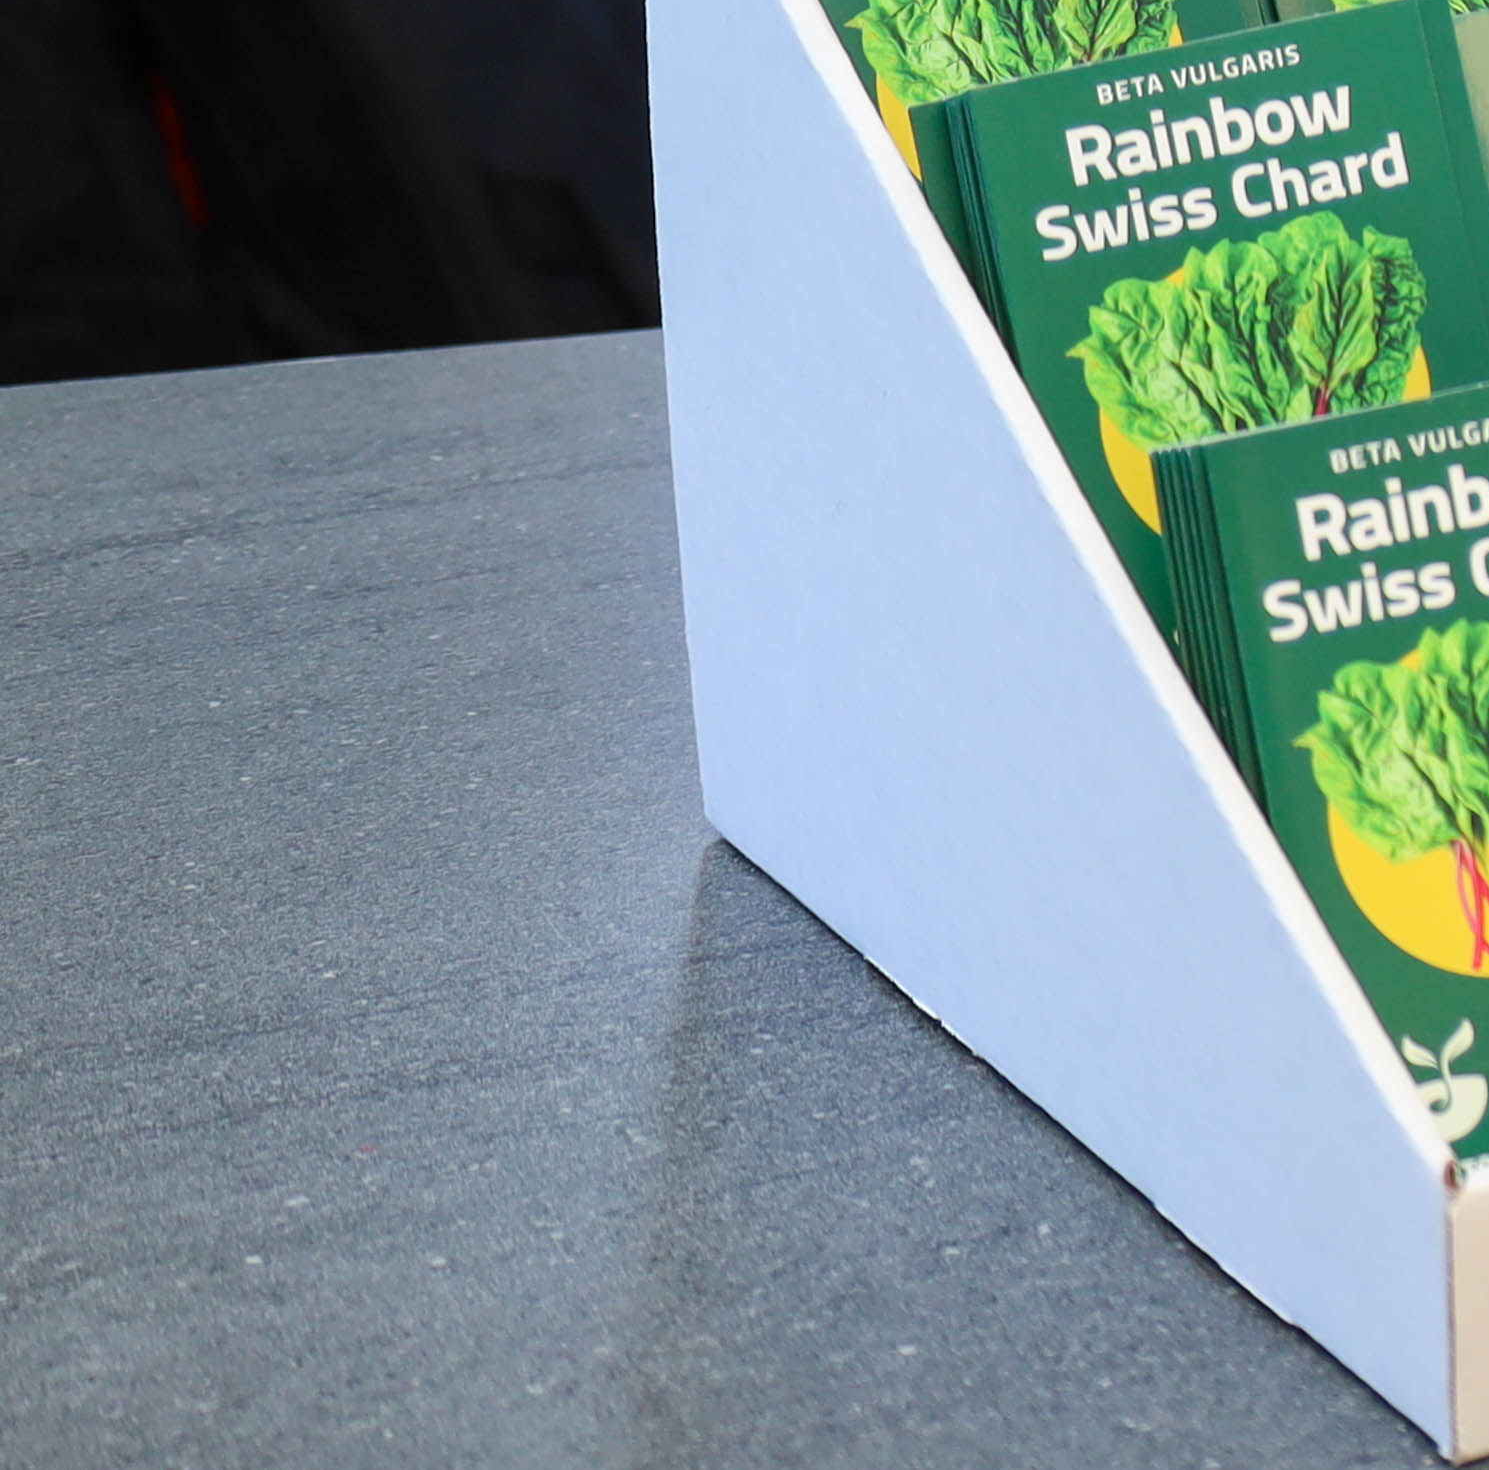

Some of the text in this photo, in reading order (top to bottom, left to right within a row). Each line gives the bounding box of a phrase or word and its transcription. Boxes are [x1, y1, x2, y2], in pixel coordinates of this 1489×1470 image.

[1095, 43, 1301, 106] BETA VULGARIS
[1064, 85, 1351, 187] Rainbow
[1035, 131, 1410, 262] Swiss Chard
[1329, 439, 1402, 474] BETA
[1262, 562, 1456, 643] Swiss
